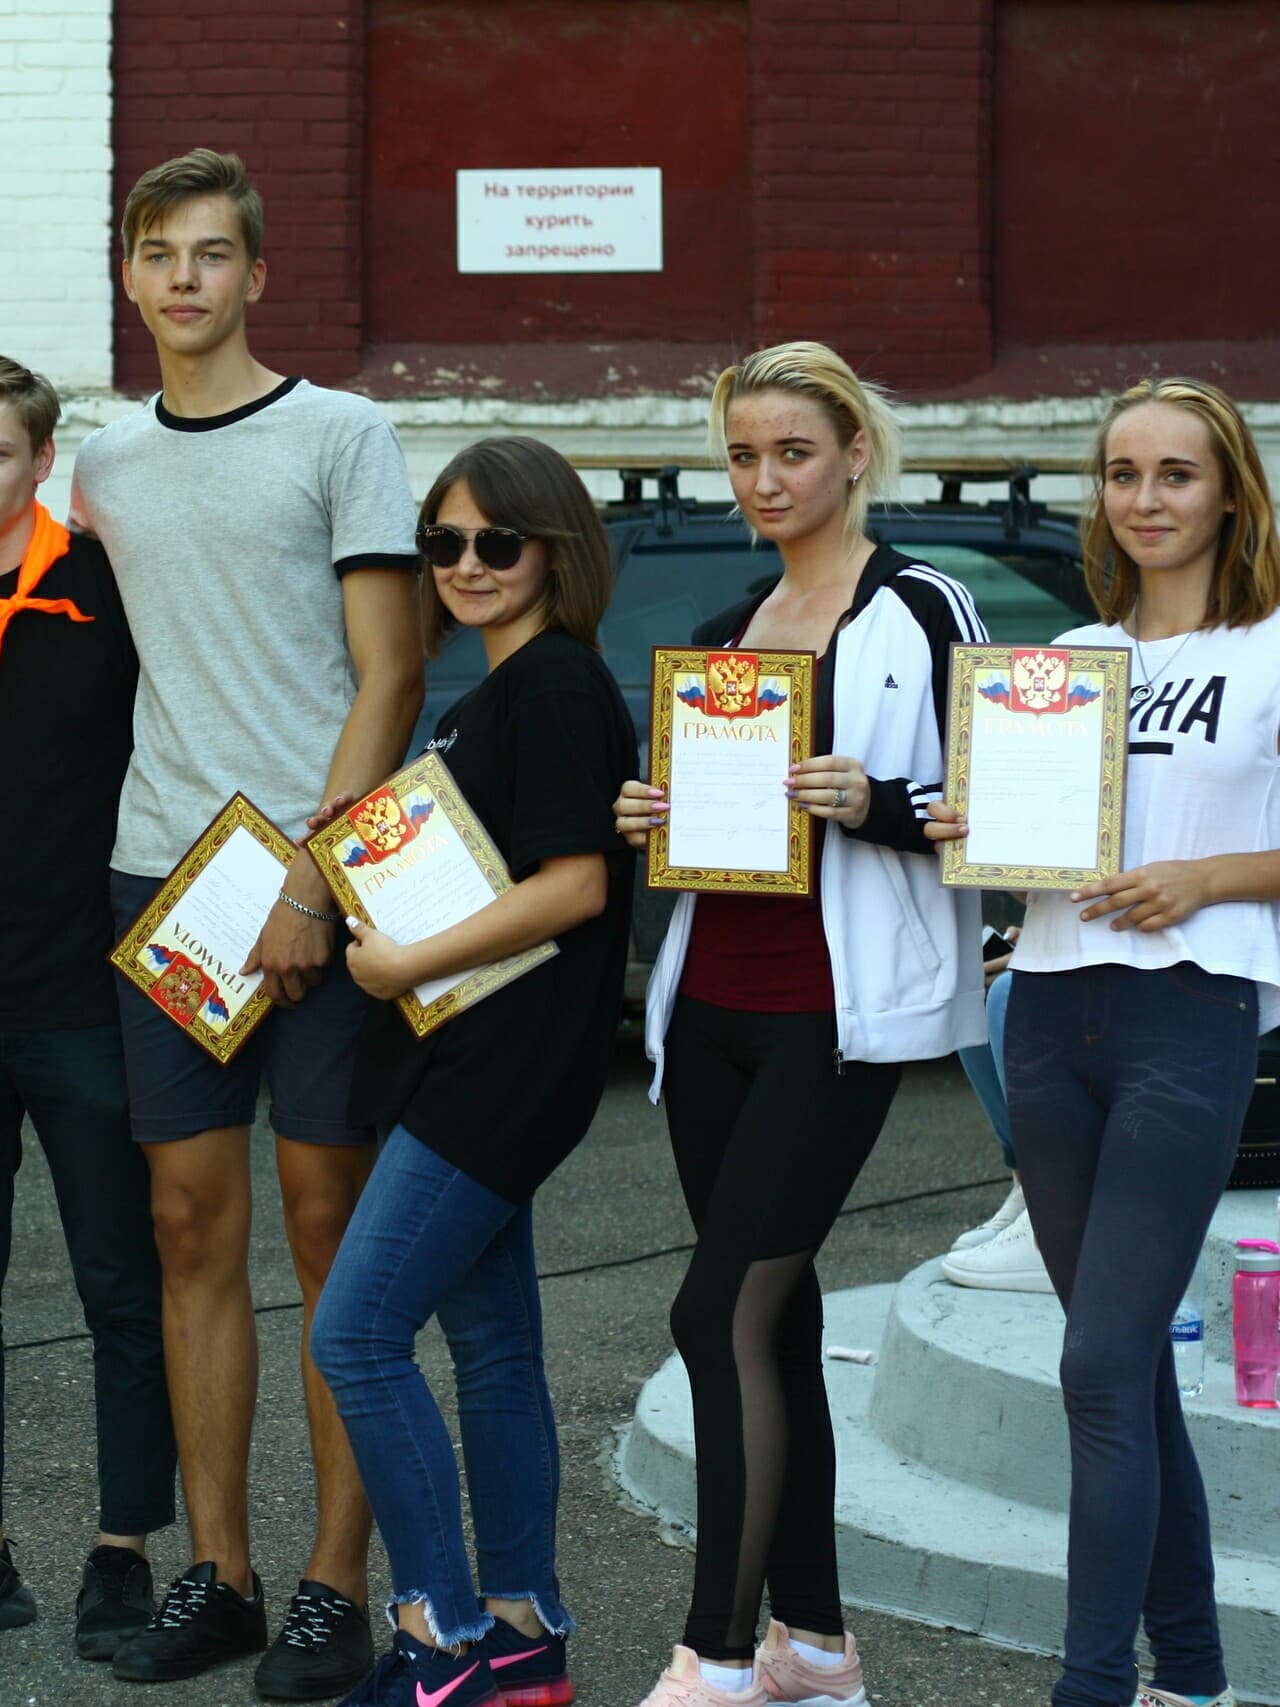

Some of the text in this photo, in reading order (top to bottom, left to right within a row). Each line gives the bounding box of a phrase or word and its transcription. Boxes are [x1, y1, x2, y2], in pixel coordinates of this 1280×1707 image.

[483, 182, 635, 200] На территории
[524, 213, 594, 230] курить
[504, 242, 616, 260] запрещено
[683, 721, 778, 743] ГРАМОТА
[363, 831, 450, 897] ГРАМОТА
[173, 921, 247, 995] ГРАМОТА
